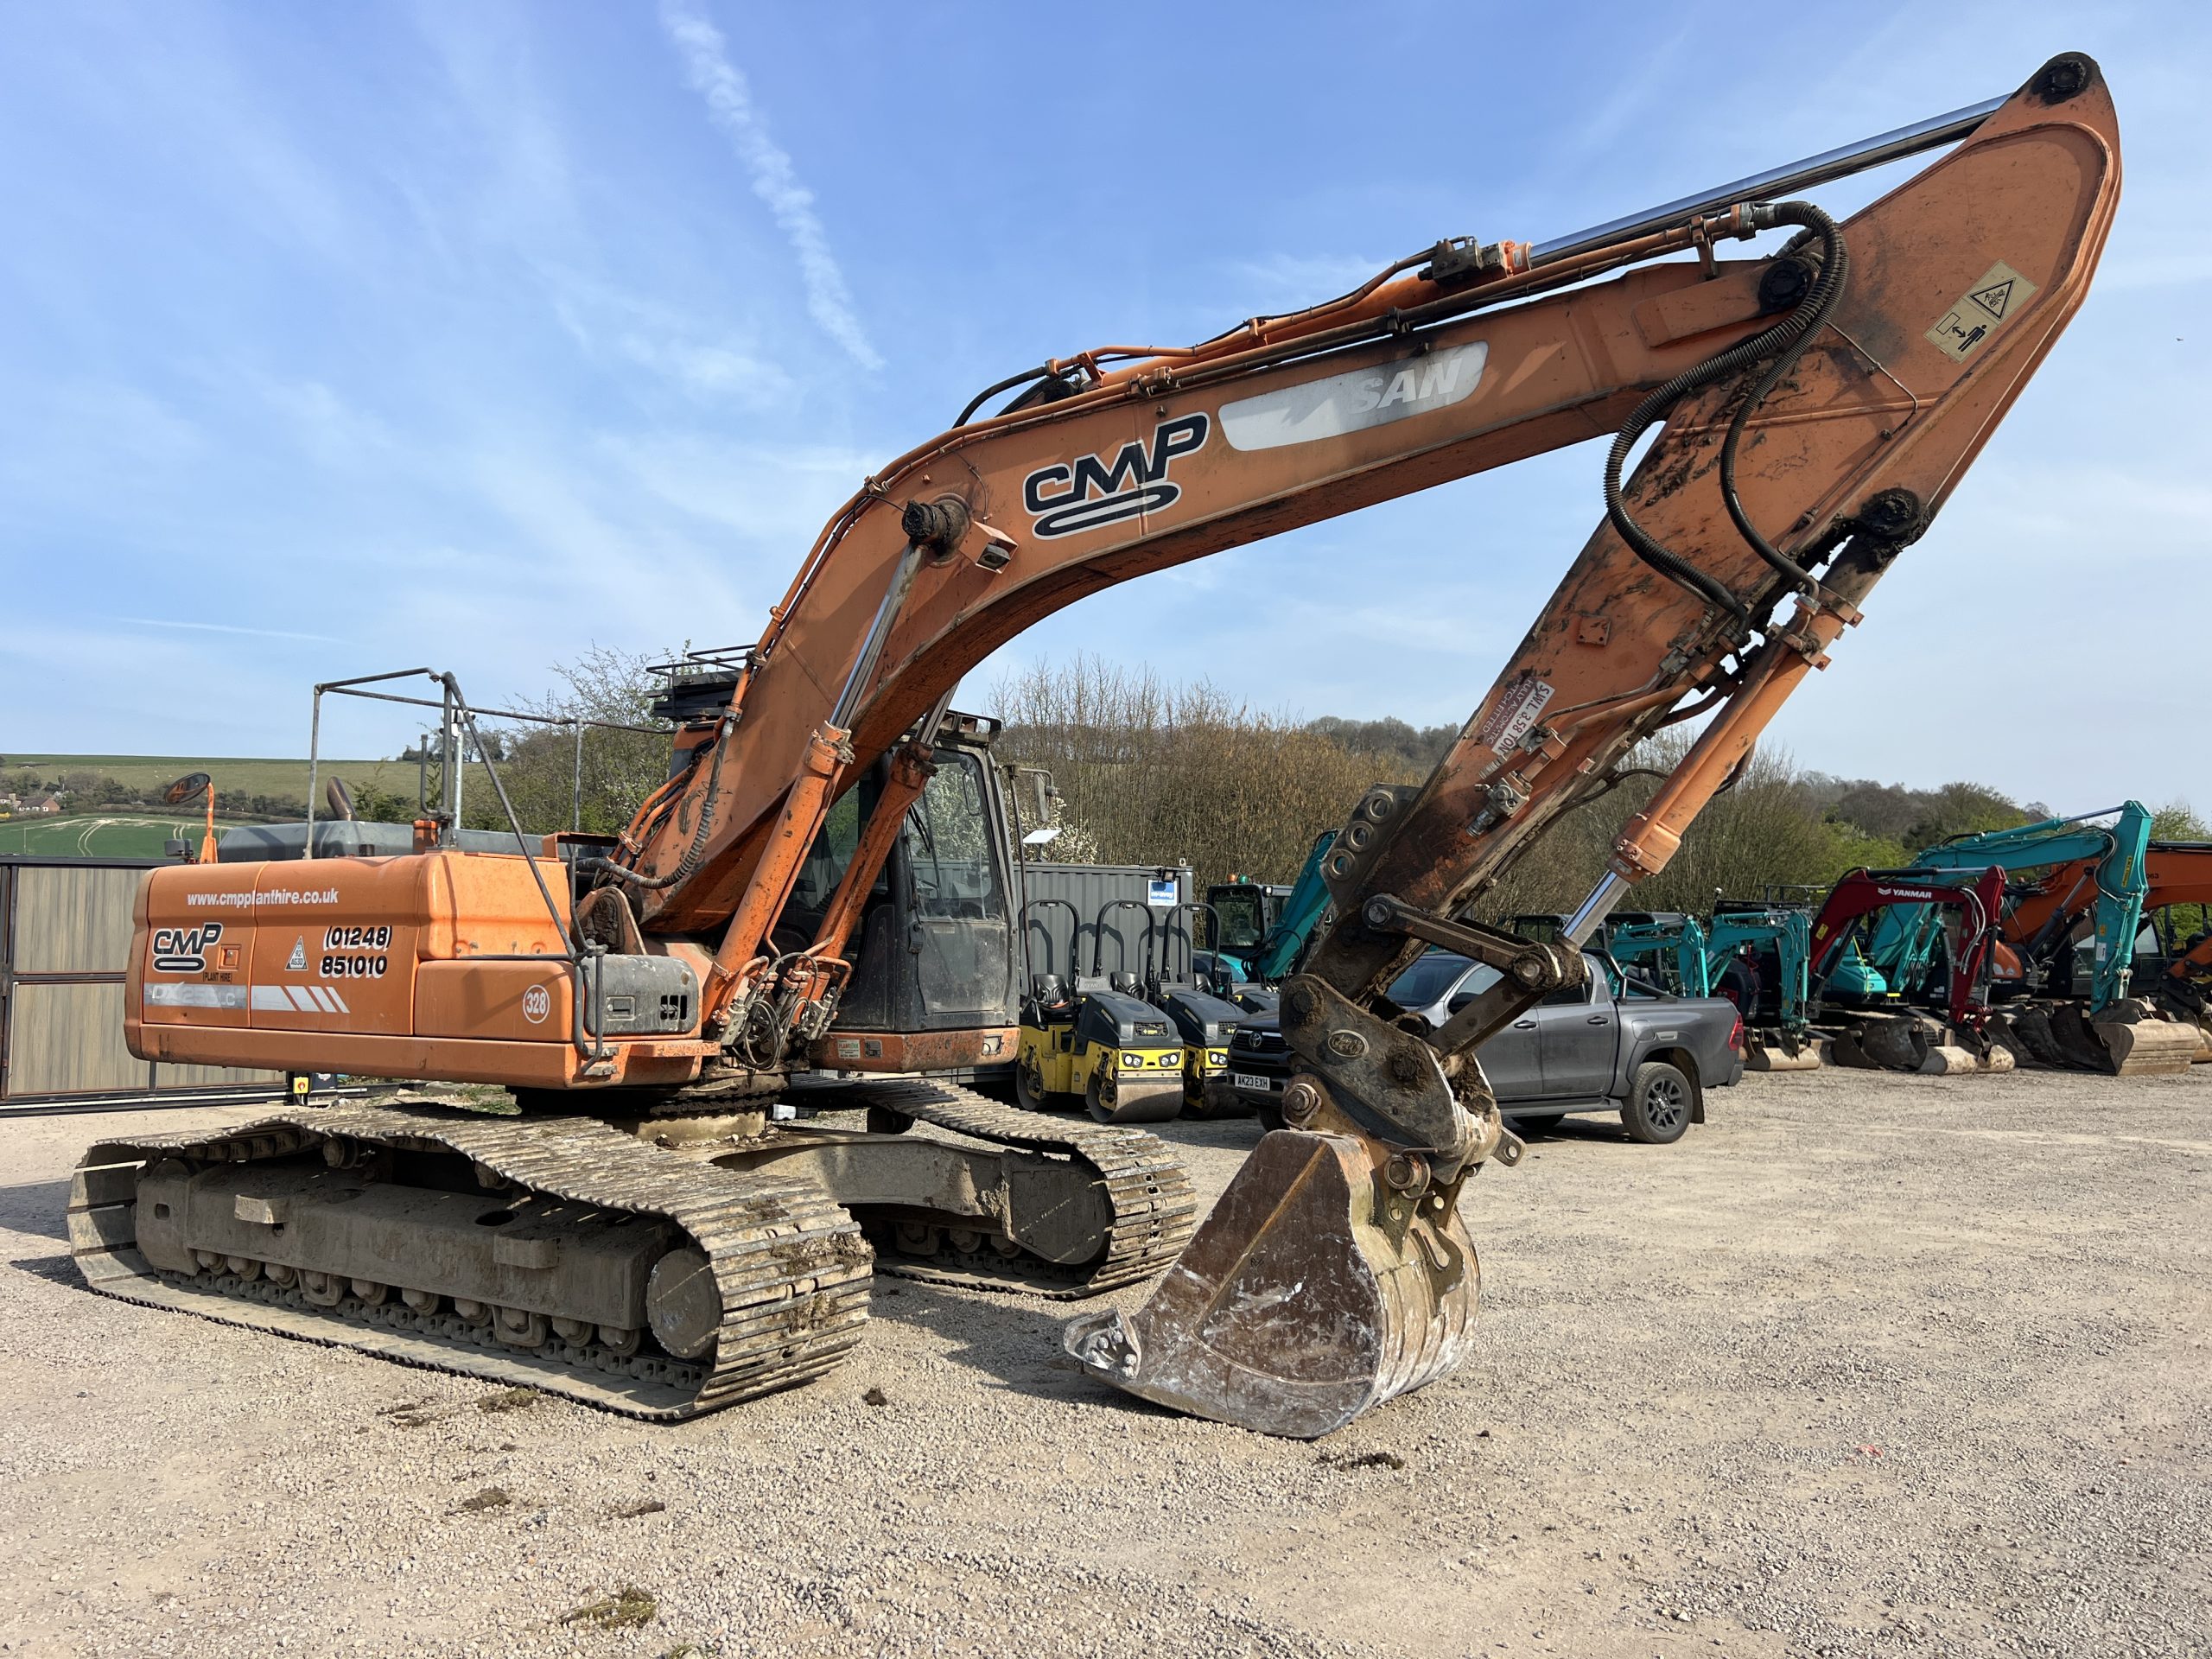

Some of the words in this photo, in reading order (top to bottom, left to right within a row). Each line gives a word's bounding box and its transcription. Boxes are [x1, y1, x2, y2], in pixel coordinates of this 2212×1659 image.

[1482, 704, 1504, 733] FITTED
[1512, 712, 1531, 733] 3.58
[1498, 733, 1518, 753] TON
[187, 888, 339, 908] www.cmpplanthire.co.uk
[1893, 888, 1932, 899] YANMAR
[153, 923, 223, 957] CMP
[323, 925, 392, 952] (01248)
[319, 955, 387, 978] 851010
[526, 992, 546, 1014] 328
[1237, 1075, 1254, 1086] AK23
[1255, 1077, 1268, 1089] EXH
